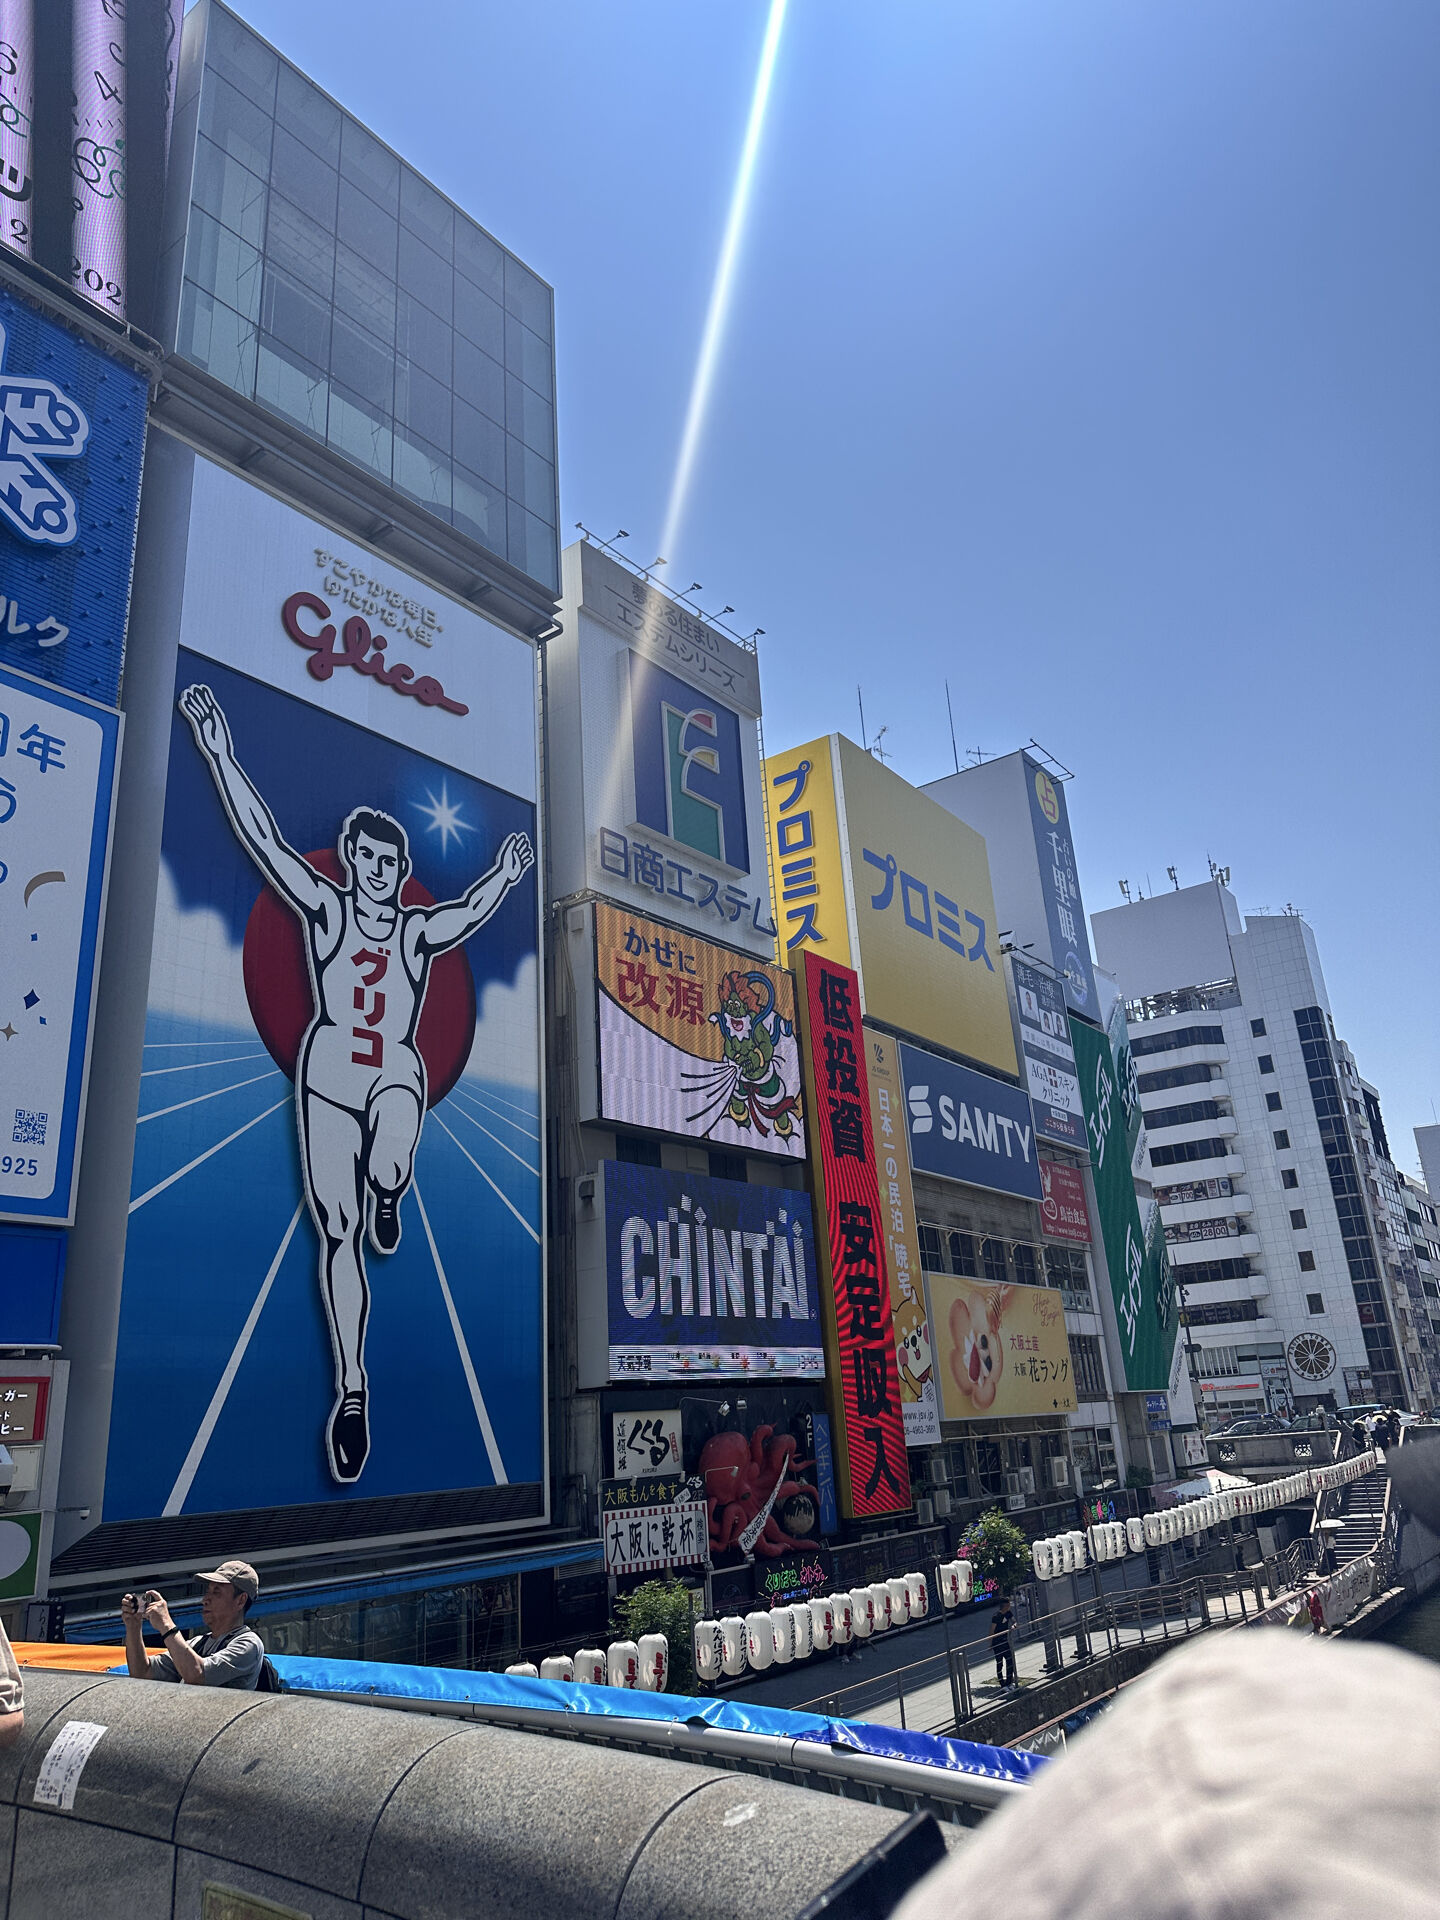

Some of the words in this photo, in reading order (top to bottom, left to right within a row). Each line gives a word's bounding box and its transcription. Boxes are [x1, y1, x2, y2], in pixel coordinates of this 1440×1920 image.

[282, 591, 470, 717] Glico
[616, 602, 738, 694] エステムシリーズ
[1040, 774, 1057, 819] 占
[600, 826, 778, 937] 日商エステム
[772, 759, 827, 950] プロミス
[861, 846, 996, 973] プロミス
[1046, 831, 1078, 949] 千里眼
[623, 926, 697, 975] かぜに
[351, 946, 391, 1069] グリコ
[615, 957, 706, 1027] 改源
[1031, 1063, 1049, 1083] AGA
[1042, 1086, 1071, 1109] クリニック
[939, 1094, 1031, 1164] SAMTY
[620, 1193, 810, 1320] CHINTAI
[1009, 1334, 1040, 1352] 大阪土産
[0, 1389, 28, 1402] ガー
[610, 1514, 695, 1565] 大阪に乾杯
